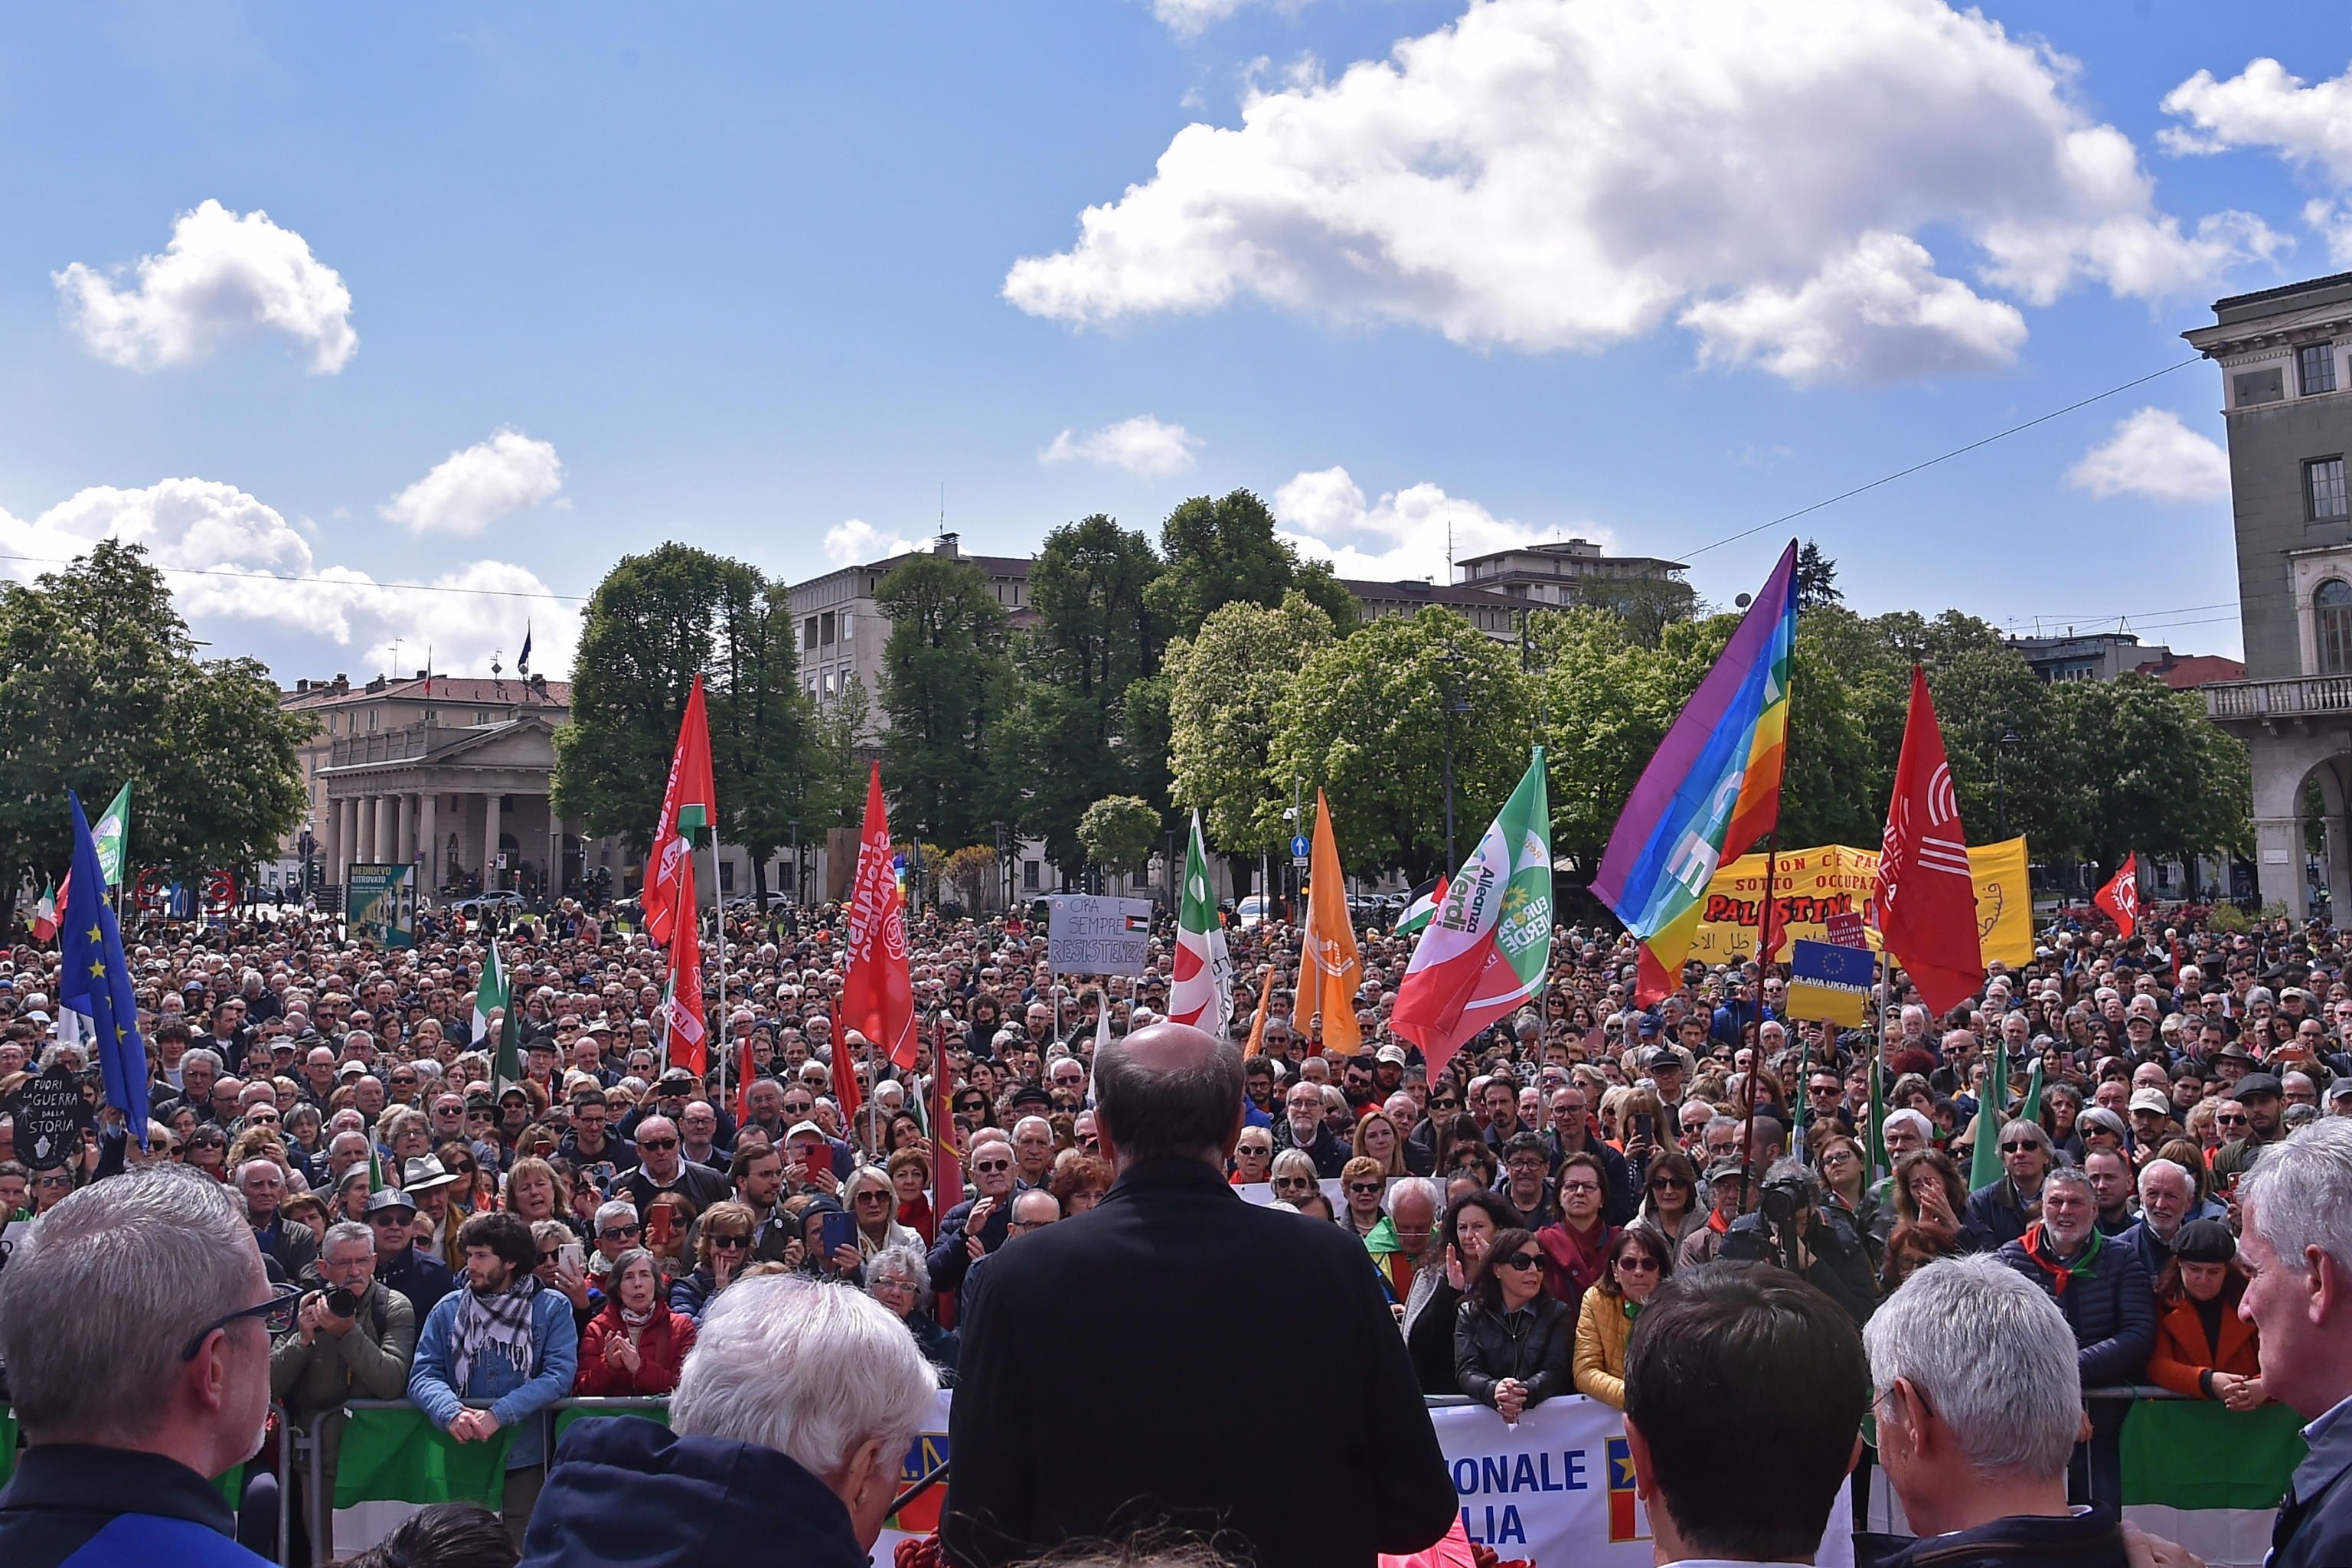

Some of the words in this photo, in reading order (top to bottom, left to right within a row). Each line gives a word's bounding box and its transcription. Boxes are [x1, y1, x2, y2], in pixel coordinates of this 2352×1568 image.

[1855, 854, 1880, 869] PAC
[351, 866, 391, 876] MEDIOEVO
[351, 875, 386, 884] RITROVATO
[1735, 877, 1793, 891] SOTTO
[1815, 874, 1877, 890] OCCUPAZ
[1070, 898, 1100, 913] ORA
[1119, 900, 1126, 915] E
[1442, 864, 1481, 932] Verdi
[1466, 866, 1495, 934] Alleanza
[1704, 892, 1852, 926] PALSTINA
[1068, 916, 1125, 935] SEMPRE
[1050, 939, 1147, 964] RESISTENZA
[1793, 974, 1824, 988] SLAVA
[1826, 980, 1869, 995] UKRAINI
[34, 1080, 63, 1090] FUORI
[33, 1093, 77, 1106] GUERRA
[41, 1109, 65, 1118] DALLA
[29, 1119, 74, 1134] STORIA
[1446, 1450, 1588, 1495] ONALE
